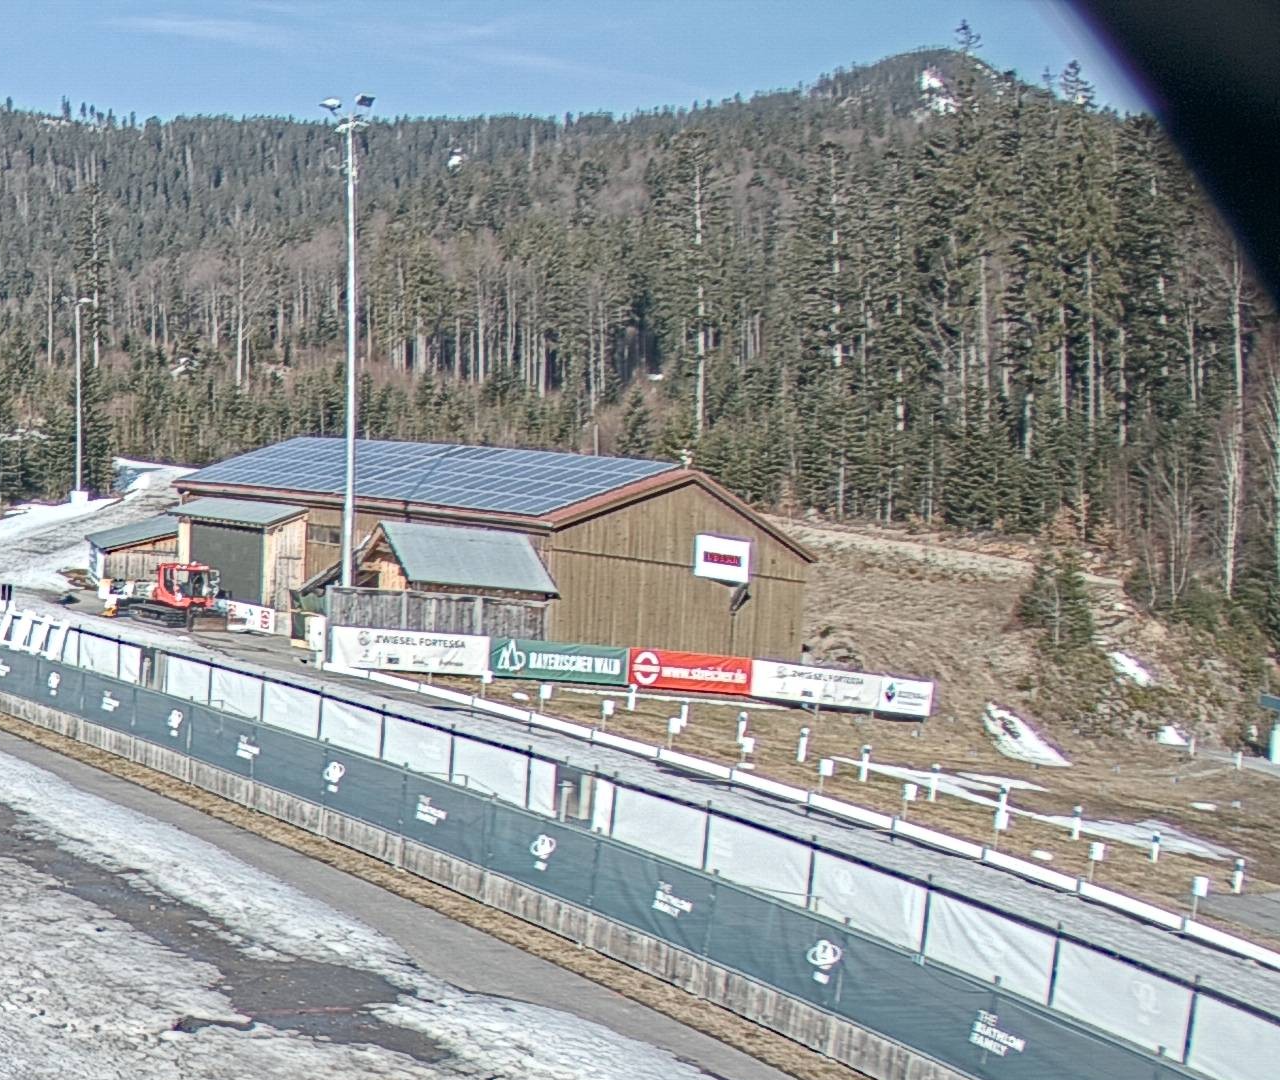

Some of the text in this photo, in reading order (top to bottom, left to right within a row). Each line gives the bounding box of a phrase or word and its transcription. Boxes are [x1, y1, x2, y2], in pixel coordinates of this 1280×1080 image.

[374, 634, 417, 647] ZWIESEL
[529, 652, 621, 676] BAYERISCHER WALD
